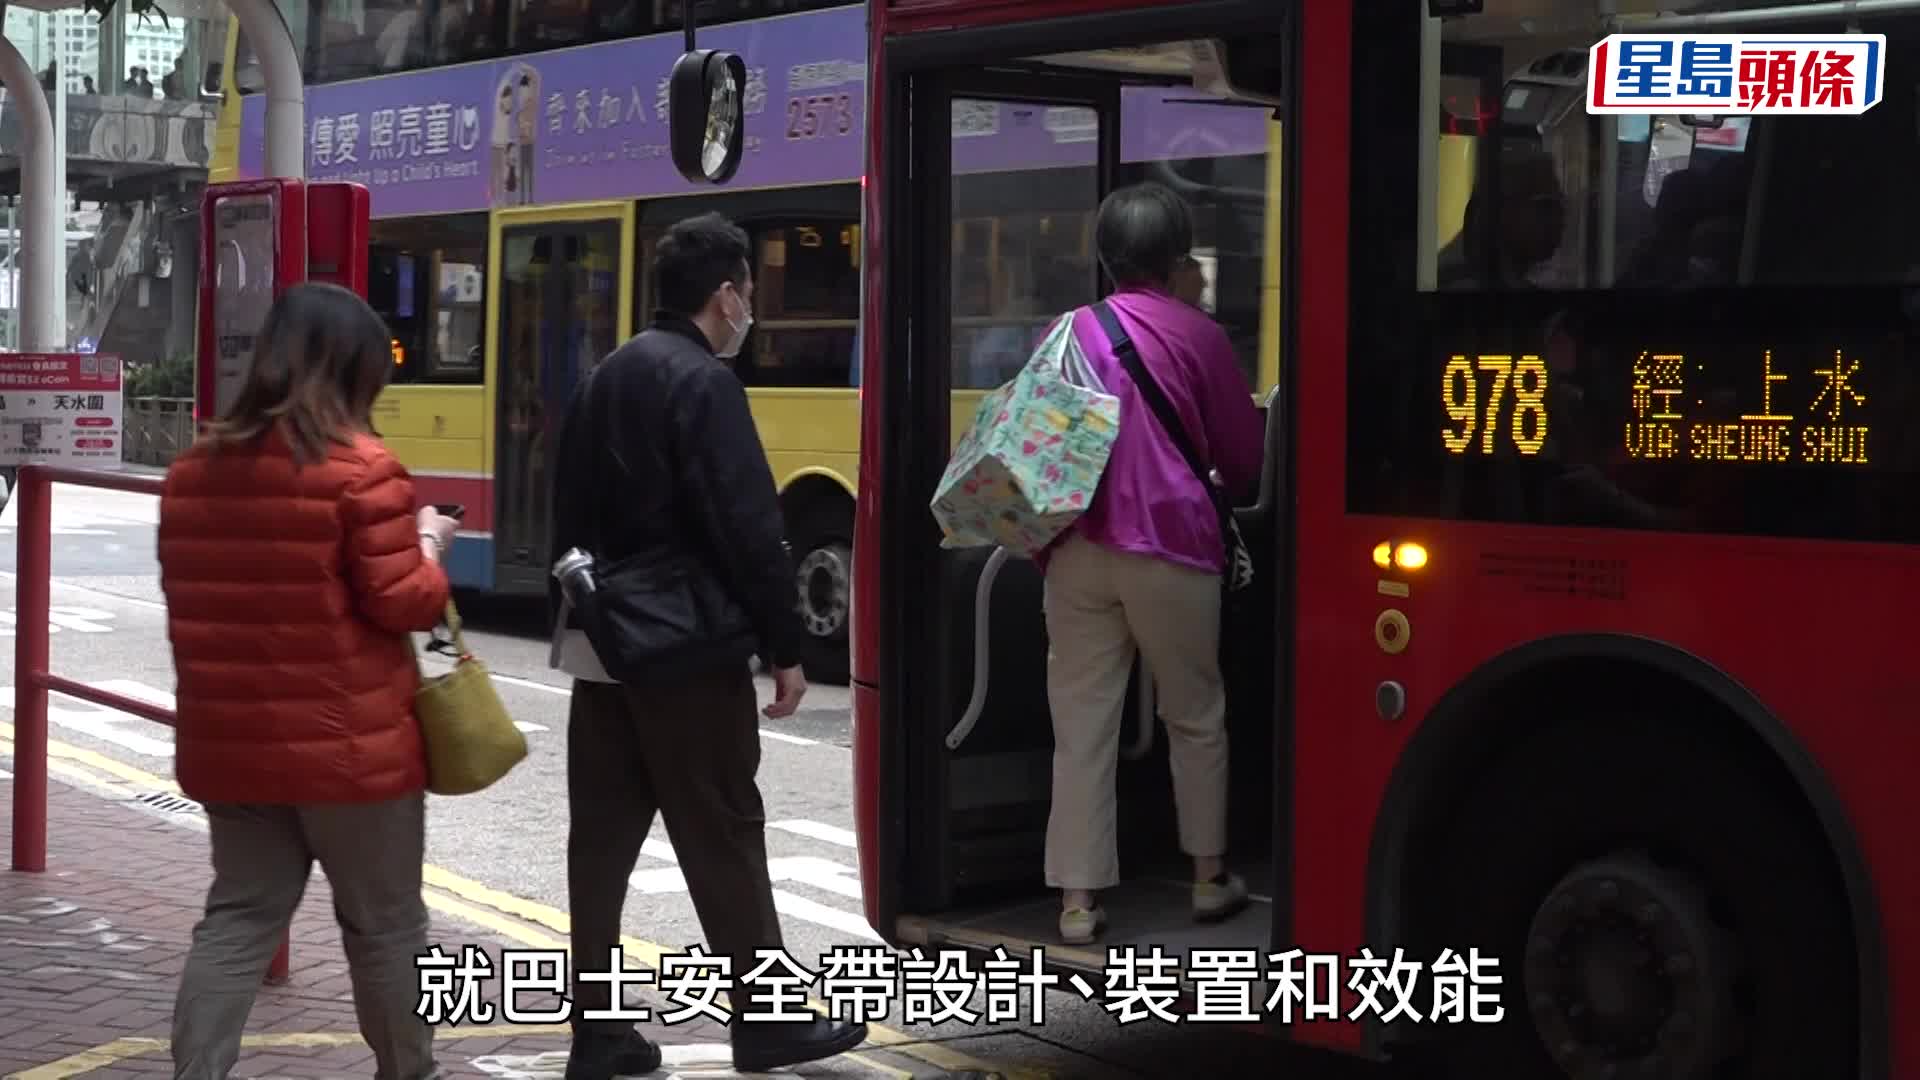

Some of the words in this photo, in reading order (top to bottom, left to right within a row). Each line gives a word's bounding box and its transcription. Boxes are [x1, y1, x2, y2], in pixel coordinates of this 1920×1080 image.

[1442, 354, 1549, 456] 978
[1690, 424, 1790, 462] SHEUNG
[1802, 426, 1868, 464] SHUI
